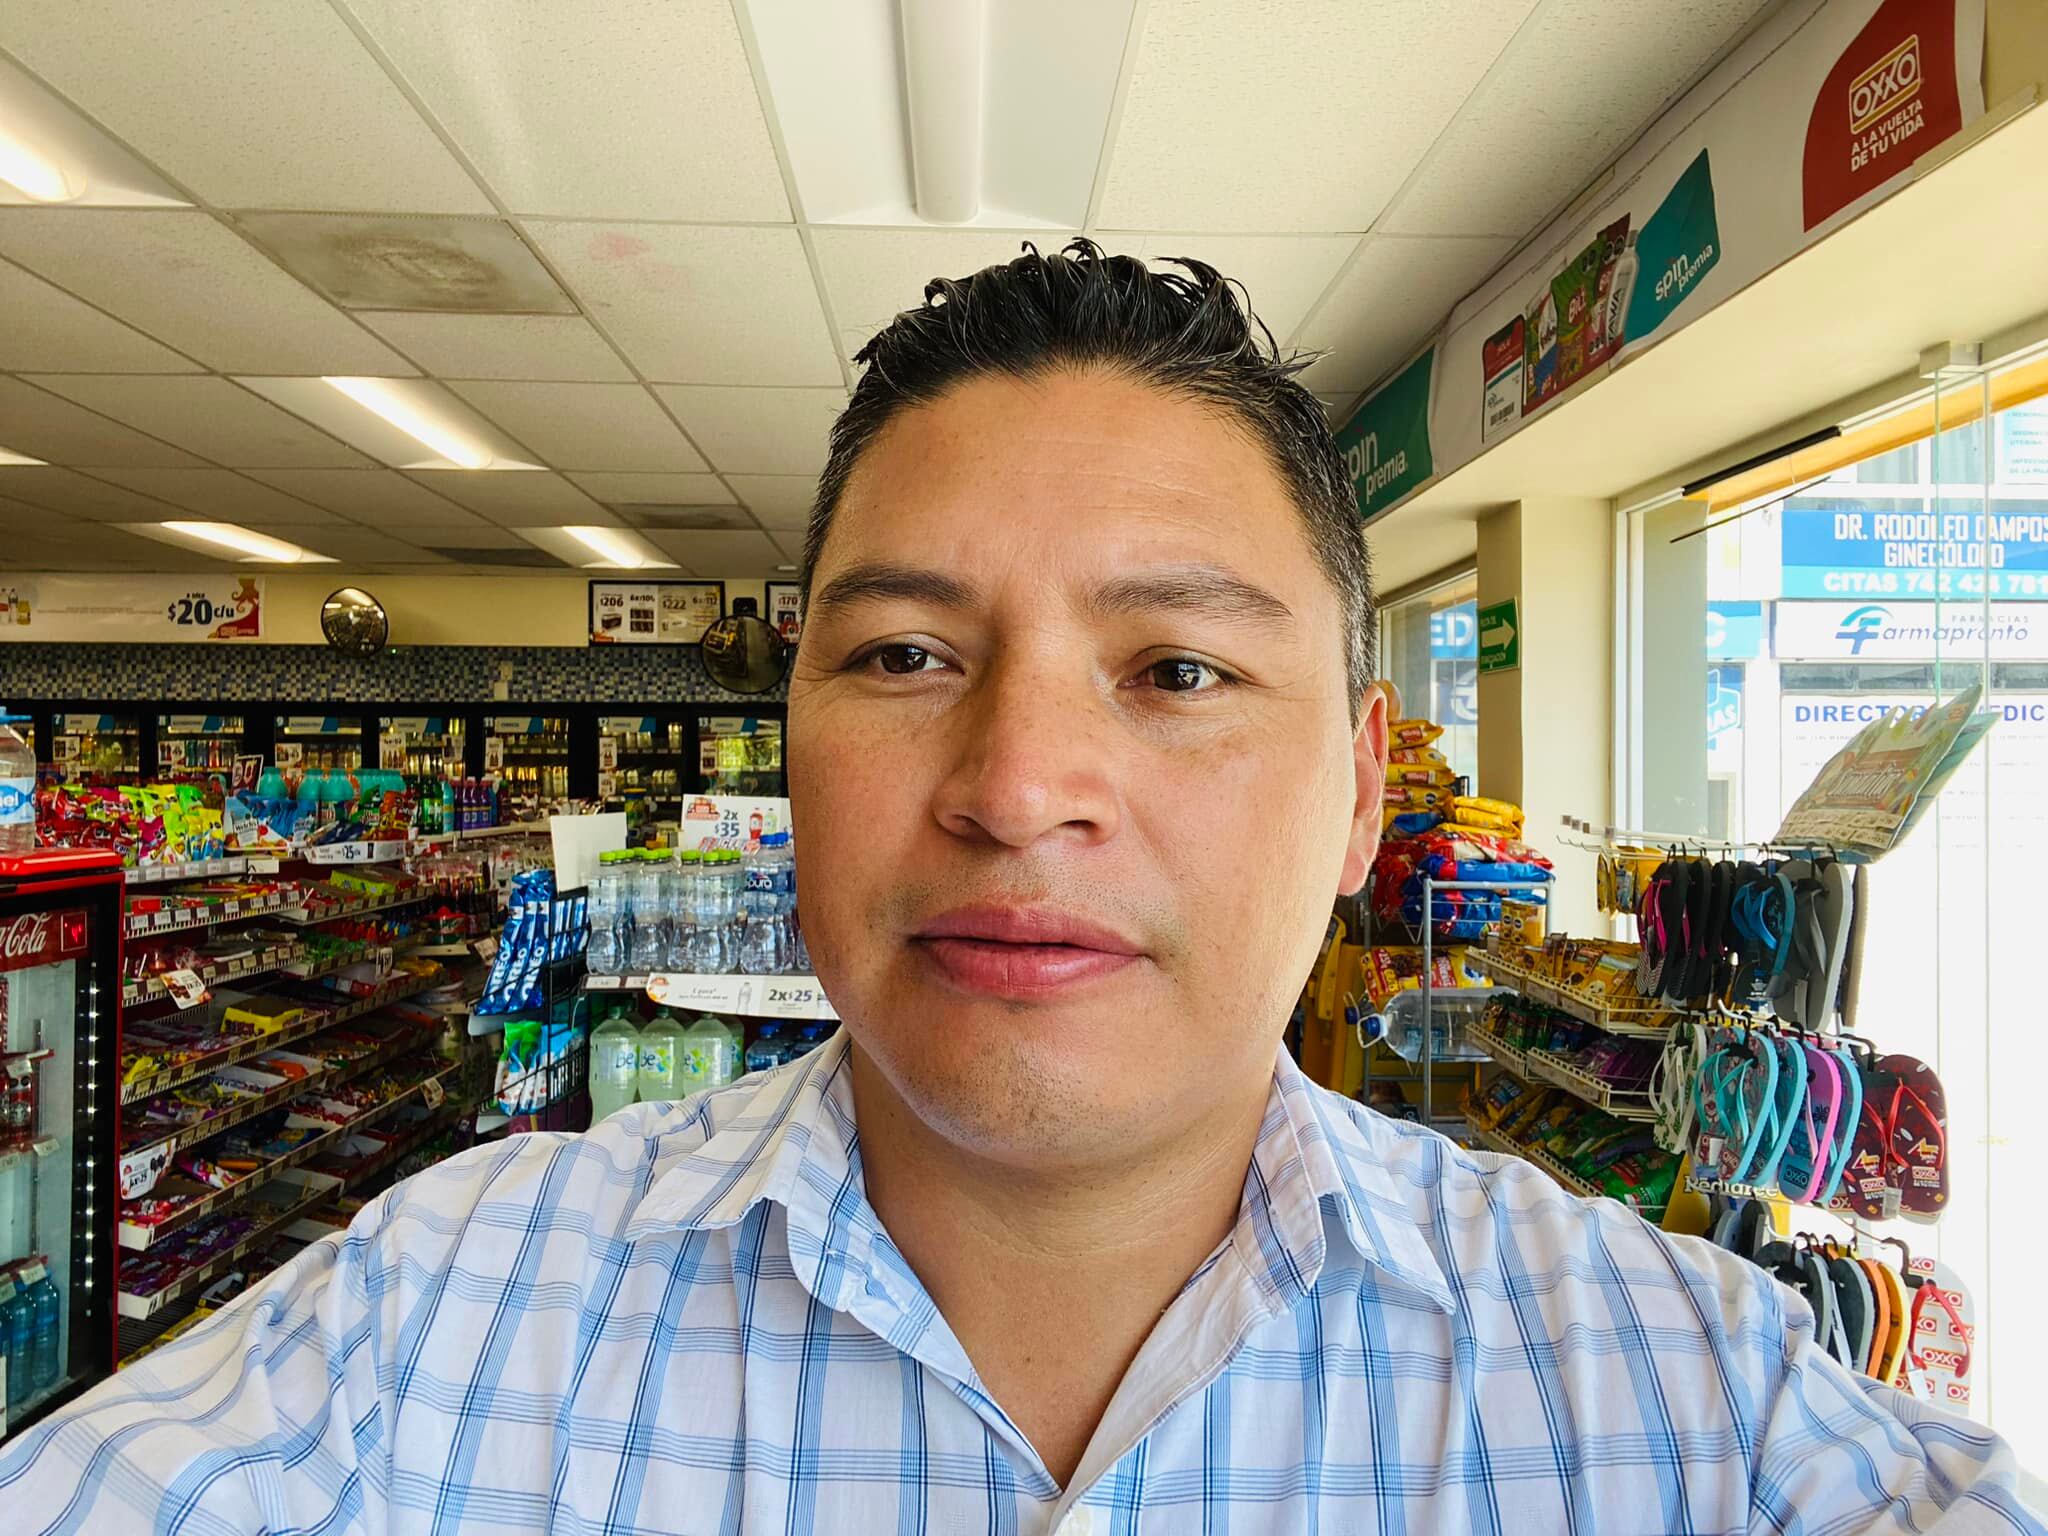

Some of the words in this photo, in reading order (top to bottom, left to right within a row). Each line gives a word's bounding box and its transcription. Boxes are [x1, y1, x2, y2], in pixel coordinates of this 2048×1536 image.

[1852, 52, 1917, 118] OXXO
[1851, 142, 1861, 156] A
[1862, 130, 1878, 148] LA
[1878, 99, 1924, 138] VUELTA
[1850, 150, 1869, 172] DE
[1869, 136, 1889, 159] TU
[1891, 114, 1925, 146] VIDA
[1655, 254, 1690, 302] spin
[1678, 244, 1714, 292] premia
[1366, 450, 1408, 505] premia
[1834, 513, 1868, 541] DR.
[1874, 514, 1969, 542] RODOLFO
[1823, 572, 1898, 593] CITAS
[1795, 704, 1927, 723] DIRECTOR
[724, 810, 738, 820] 2x
[714, 822, 740, 838] $35
[1785, 1168, 1809, 1184] OXXO
[1829, 1196, 1851, 1209] OX
[1949, 1386, 1970, 1400] OX
